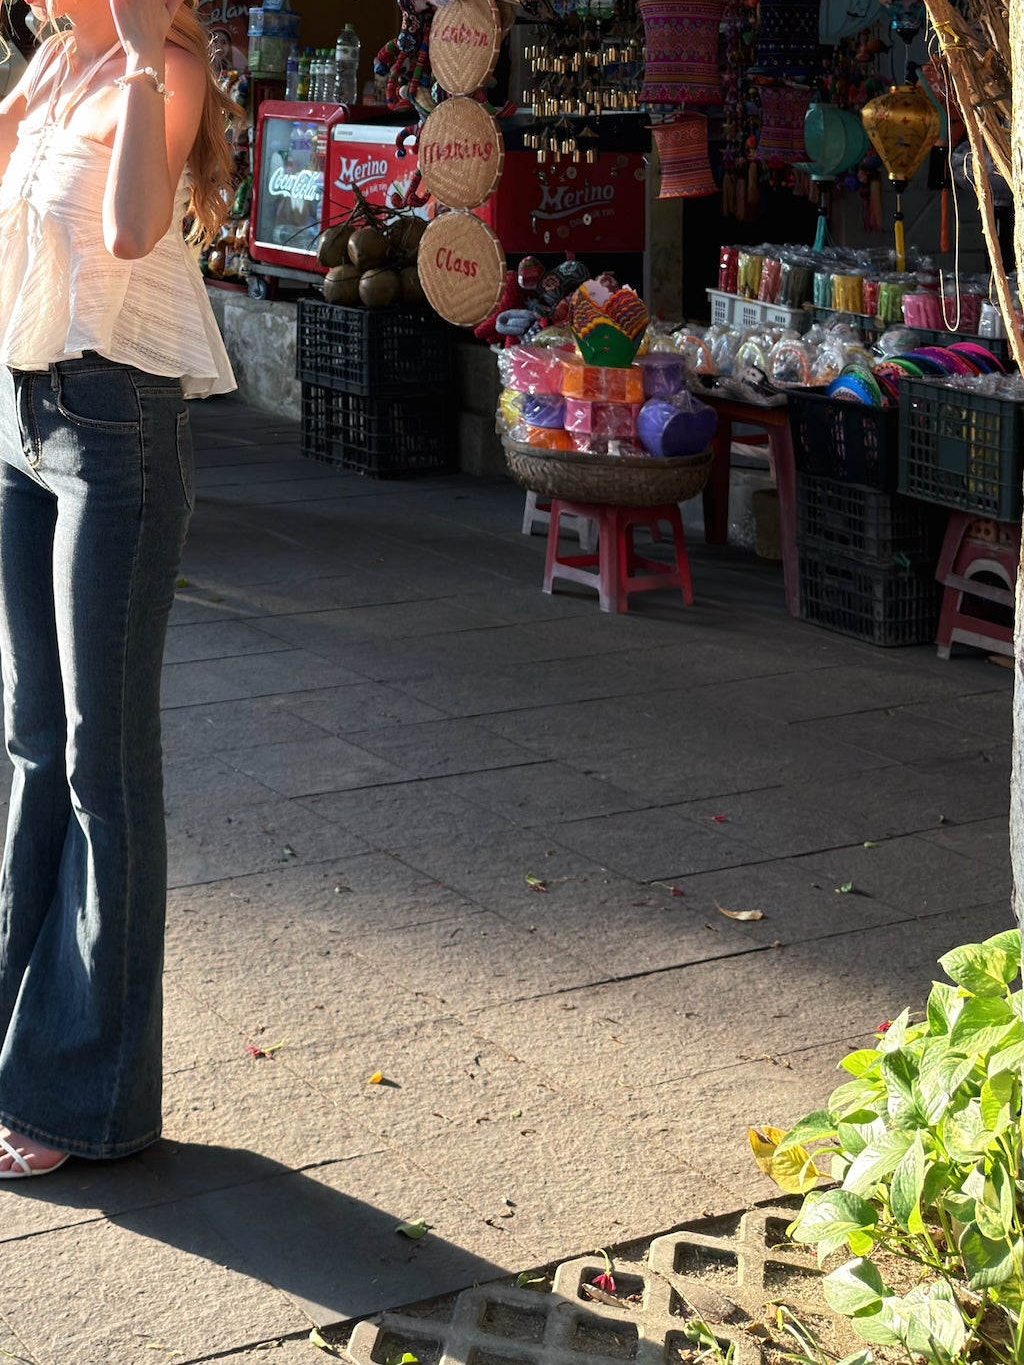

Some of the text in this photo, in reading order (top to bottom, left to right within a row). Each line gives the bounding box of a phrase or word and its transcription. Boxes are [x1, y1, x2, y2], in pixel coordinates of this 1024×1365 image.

[424, 138, 493, 164] Making
[339, 154, 388, 184] Merino
[537, 178, 616, 212] Merino
[435, 247, 479, 278] Class
